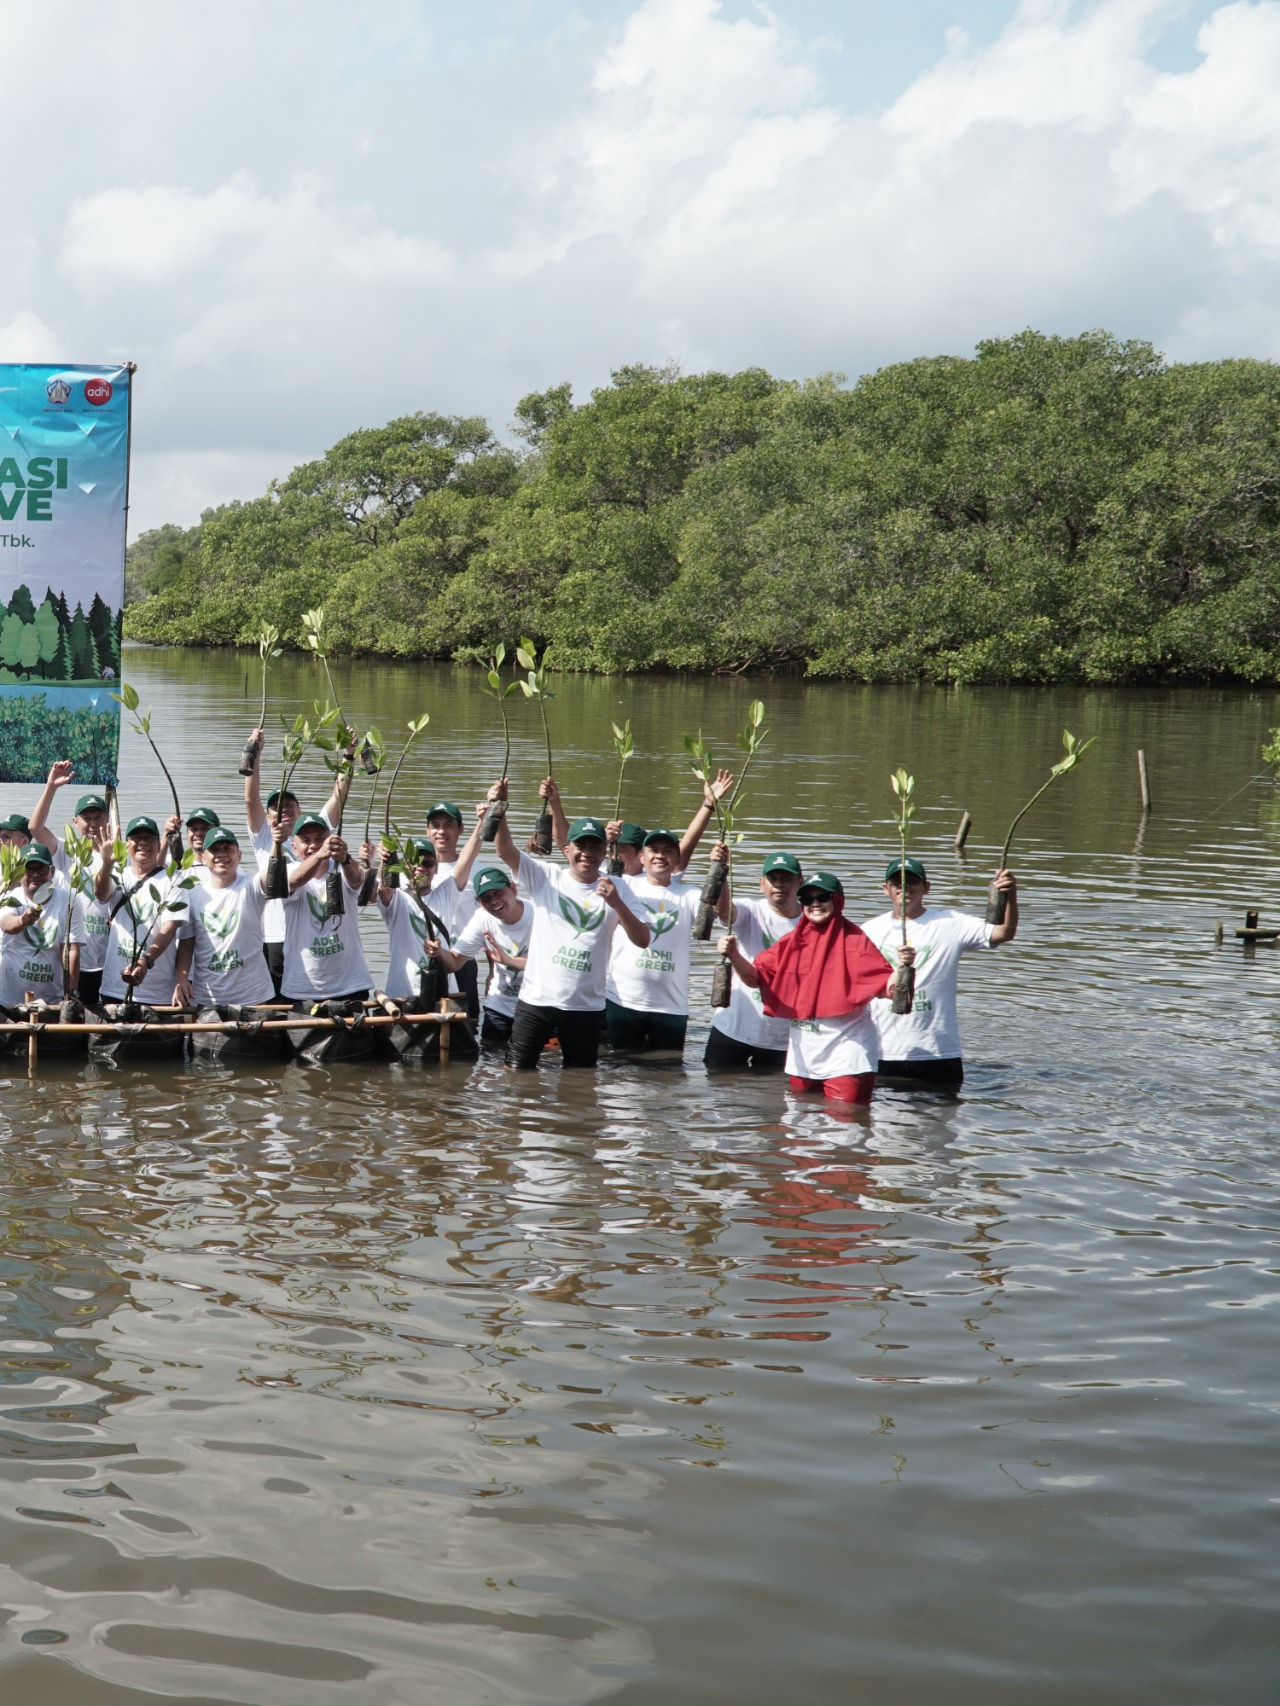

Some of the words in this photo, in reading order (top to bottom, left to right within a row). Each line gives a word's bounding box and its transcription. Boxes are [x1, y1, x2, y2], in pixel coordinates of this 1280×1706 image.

[87, 387, 110, 397] adhi
[0, 534, 35, 548] Tbk.
[313, 933, 340, 946] ADHI
[310, 942, 345, 956] GREEN
[558, 945, 592, 961] ADHI
[641, 948, 673, 961] ADHI
[23, 961, 52, 973] ADHI
[552, 954, 593, 973] GREEN
[636, 958, 675, 972] GREEN
[19, 969, 54, 983] GREEN
